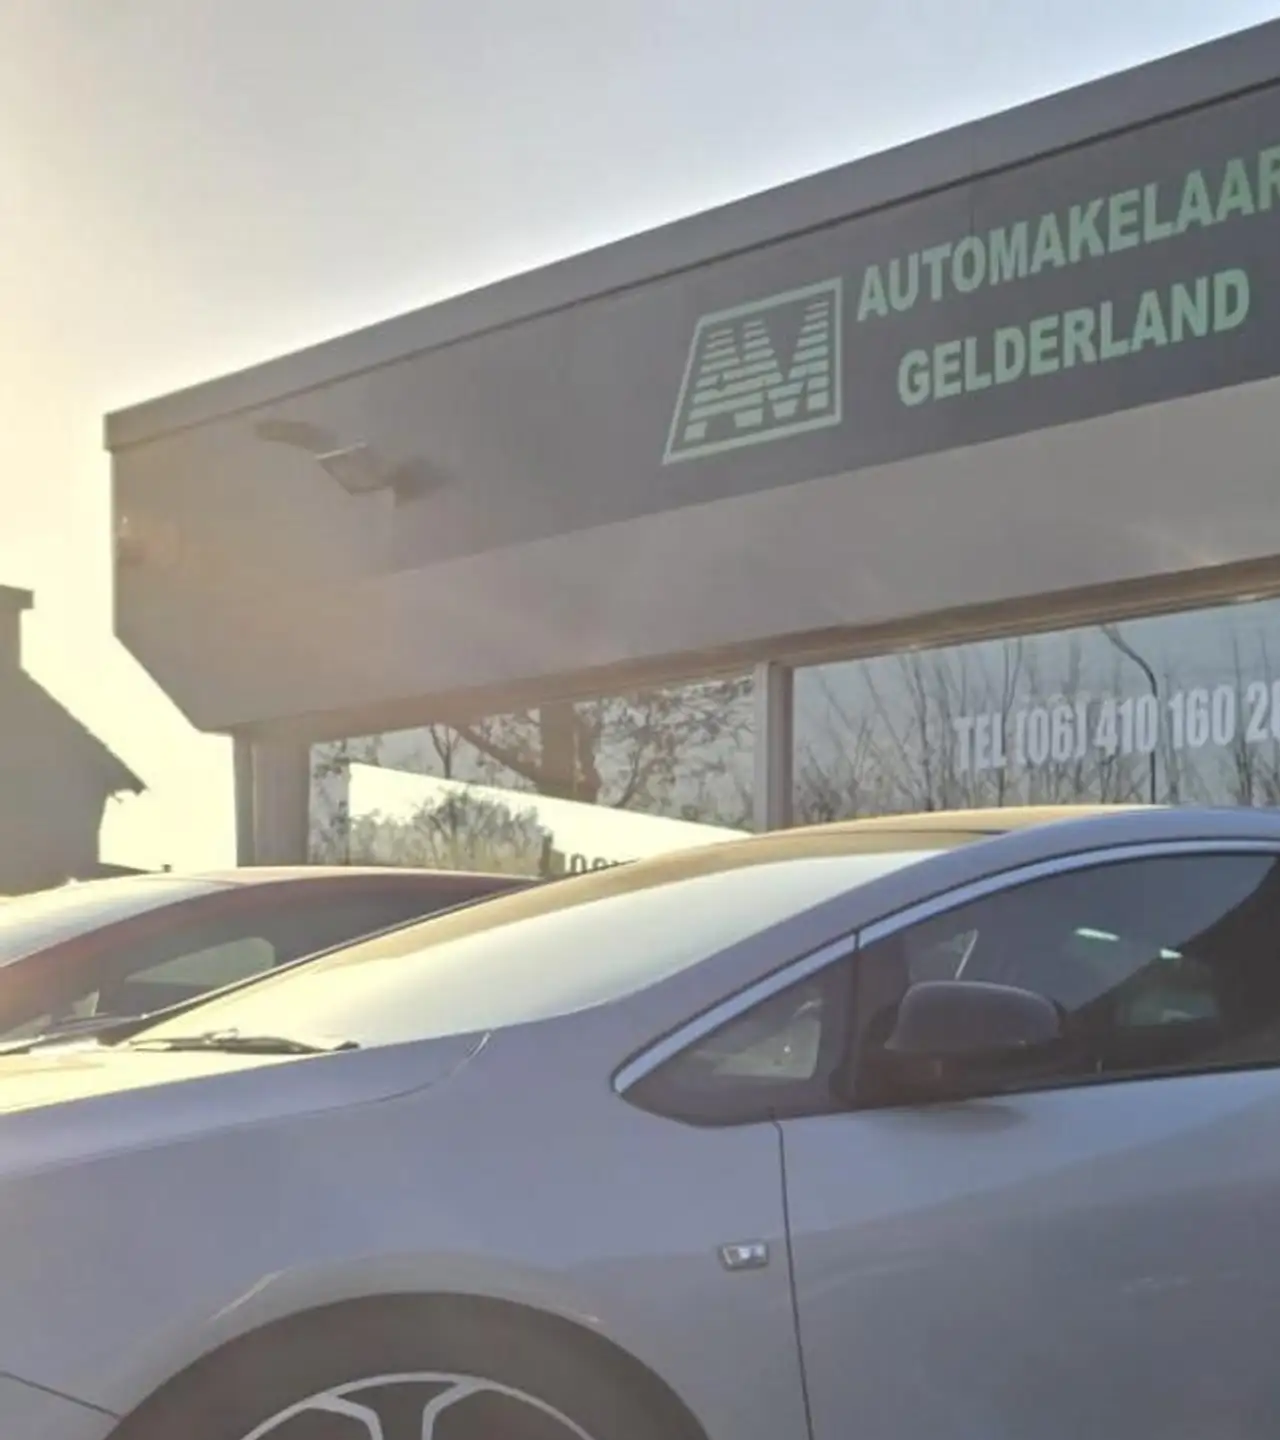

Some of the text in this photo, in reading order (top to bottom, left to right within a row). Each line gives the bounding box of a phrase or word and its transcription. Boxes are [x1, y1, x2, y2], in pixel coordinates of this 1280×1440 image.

[899, 268, 1249, 407] GELDERLAND
[953, 711, 1007, 771] TEL
[1093, 694, 1158, 757] 410
[1169, 684, 1236, 749] 160
